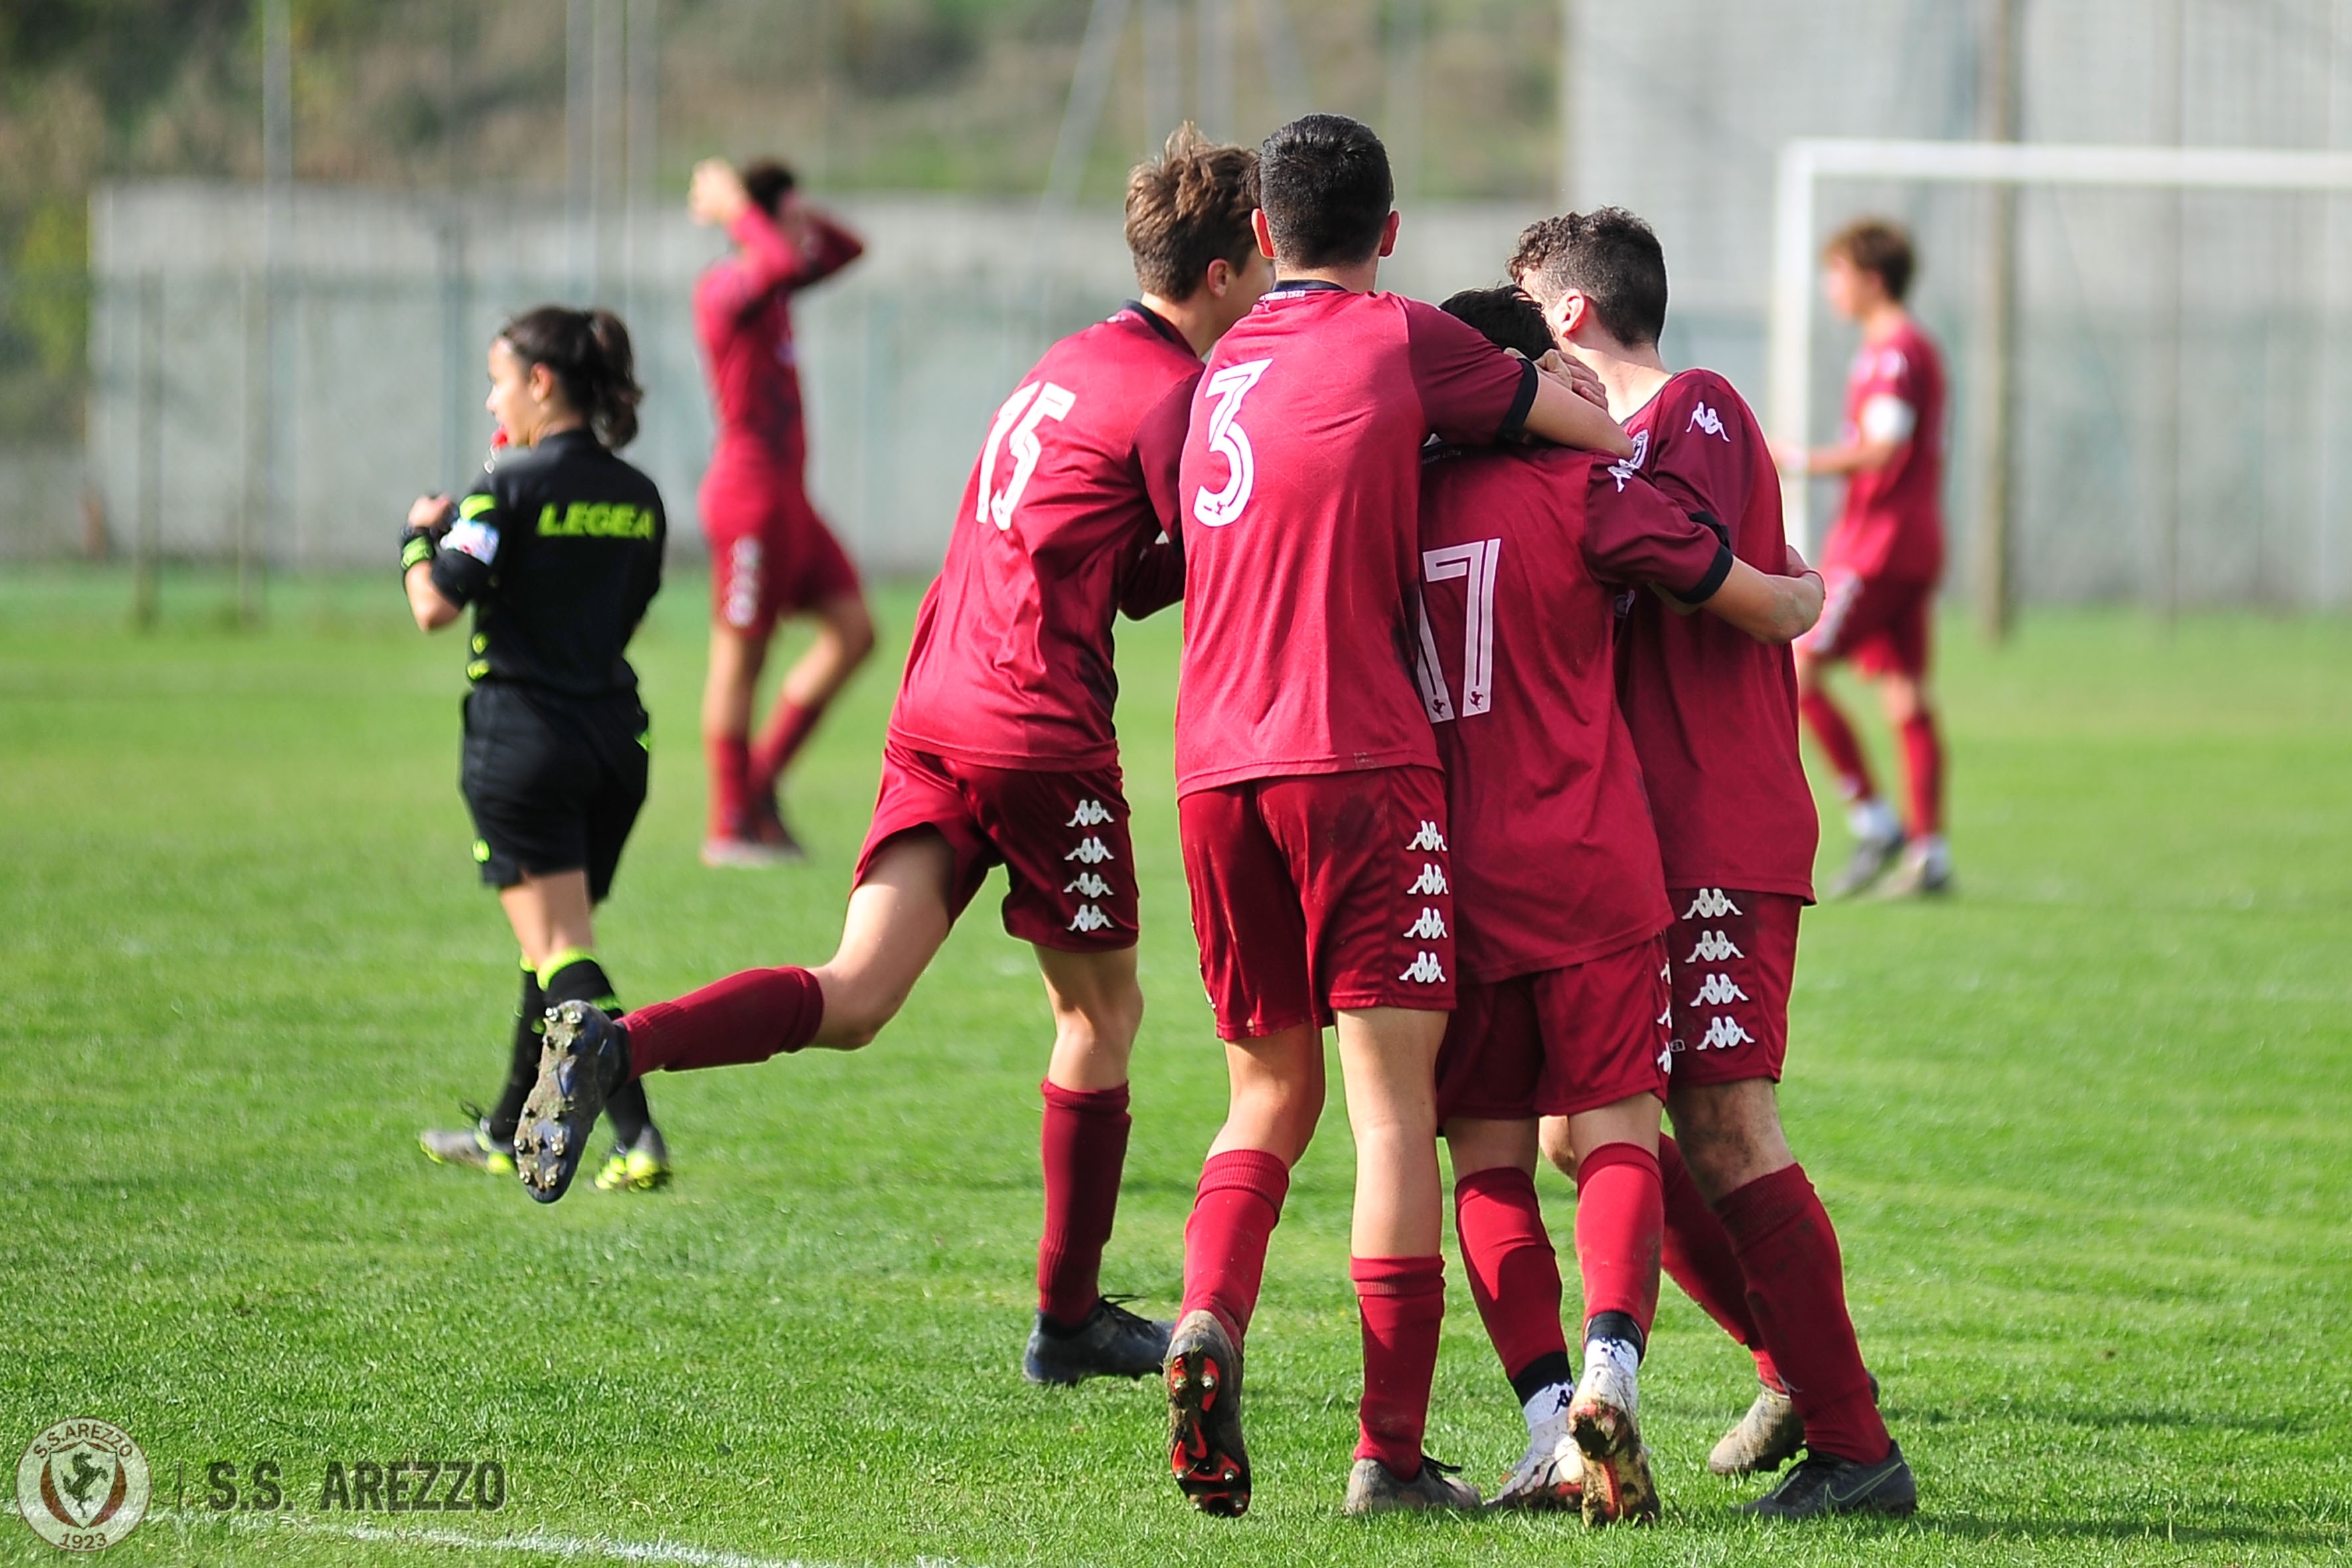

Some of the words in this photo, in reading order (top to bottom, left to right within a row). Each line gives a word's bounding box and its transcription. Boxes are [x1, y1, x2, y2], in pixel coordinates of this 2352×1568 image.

[976, 380, 1077, 530] 15
[1194, 358, 1273, 528] 3
[536, 502, 657, 540] LEGEA
